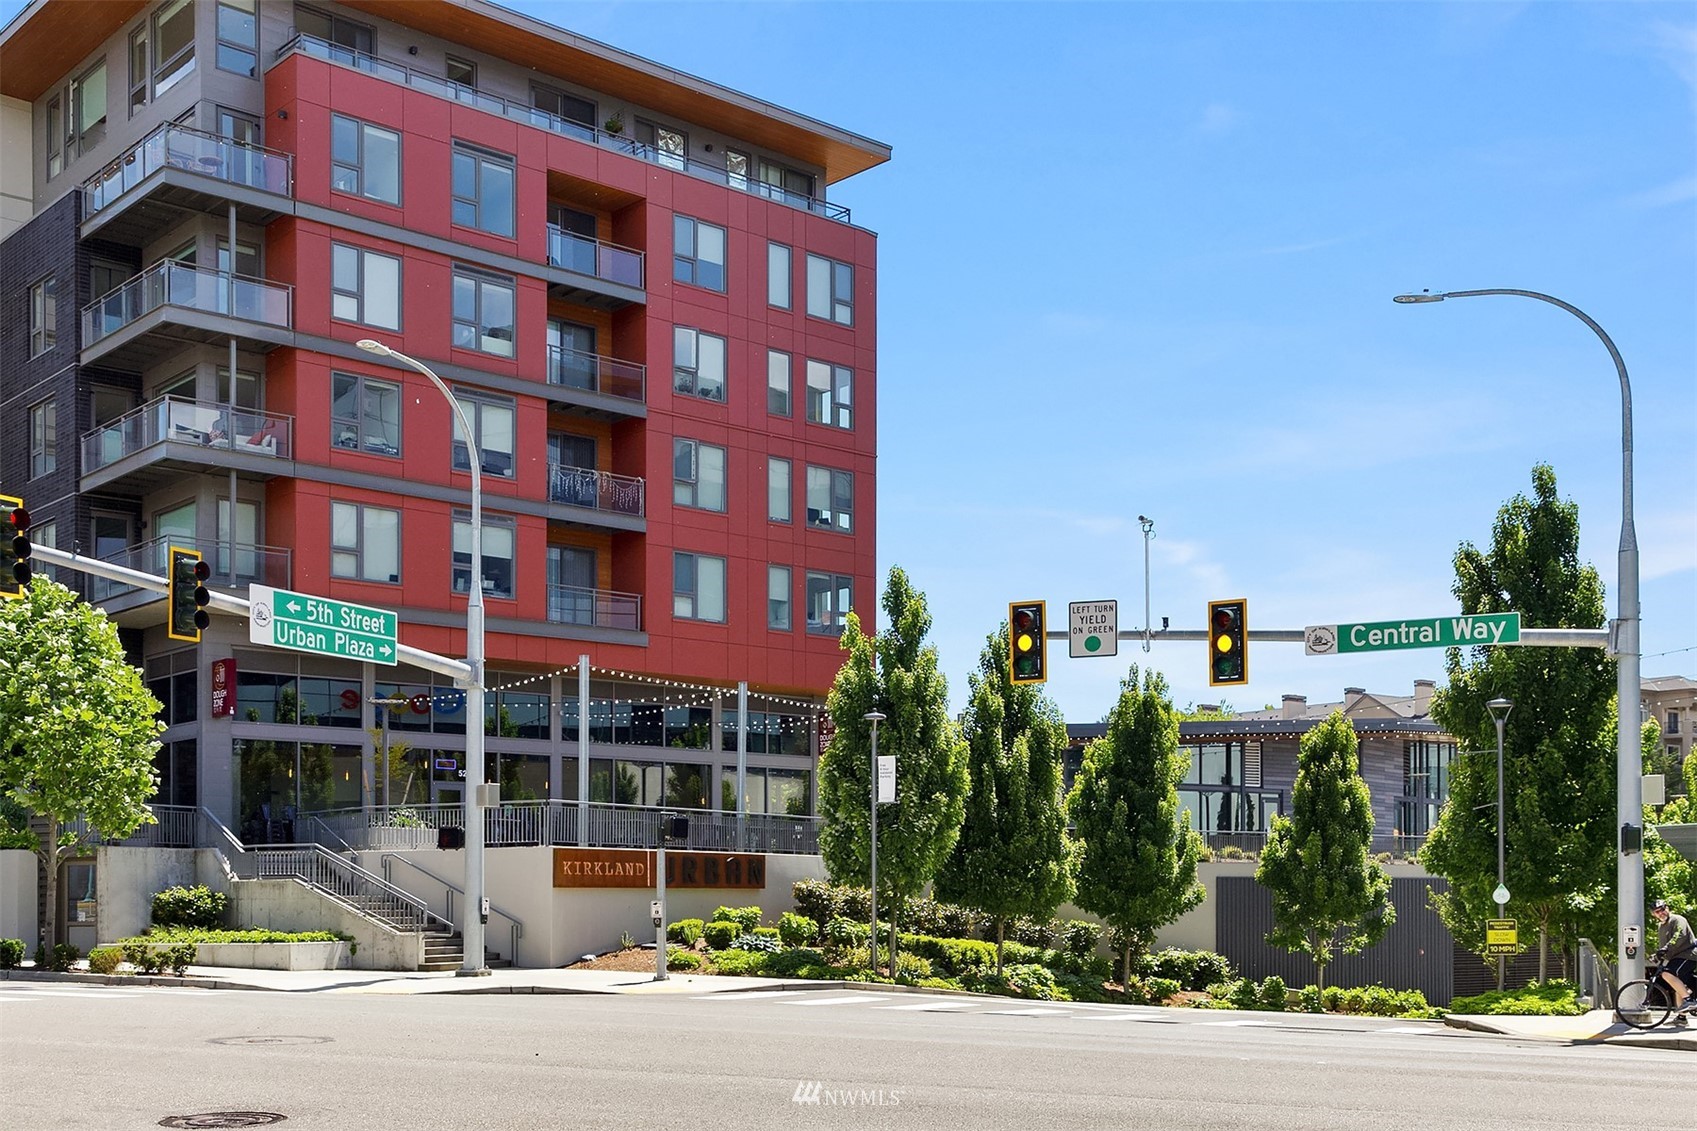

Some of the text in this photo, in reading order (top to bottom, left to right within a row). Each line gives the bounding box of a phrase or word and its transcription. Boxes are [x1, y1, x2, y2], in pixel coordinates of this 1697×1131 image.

[307, 600, 385, 633] 5th Street
[1072, 605, 1114, 614] LEFT TURN
[1079, 614, 1107, 624] YIELD
[1087, 626, 1114, 634] GREEN
[1350, 618, 1507, 646] Central Way
[277, 621, 374, 658] Urban Plaza
[562, 860, 645, 876] KIRKLAND
